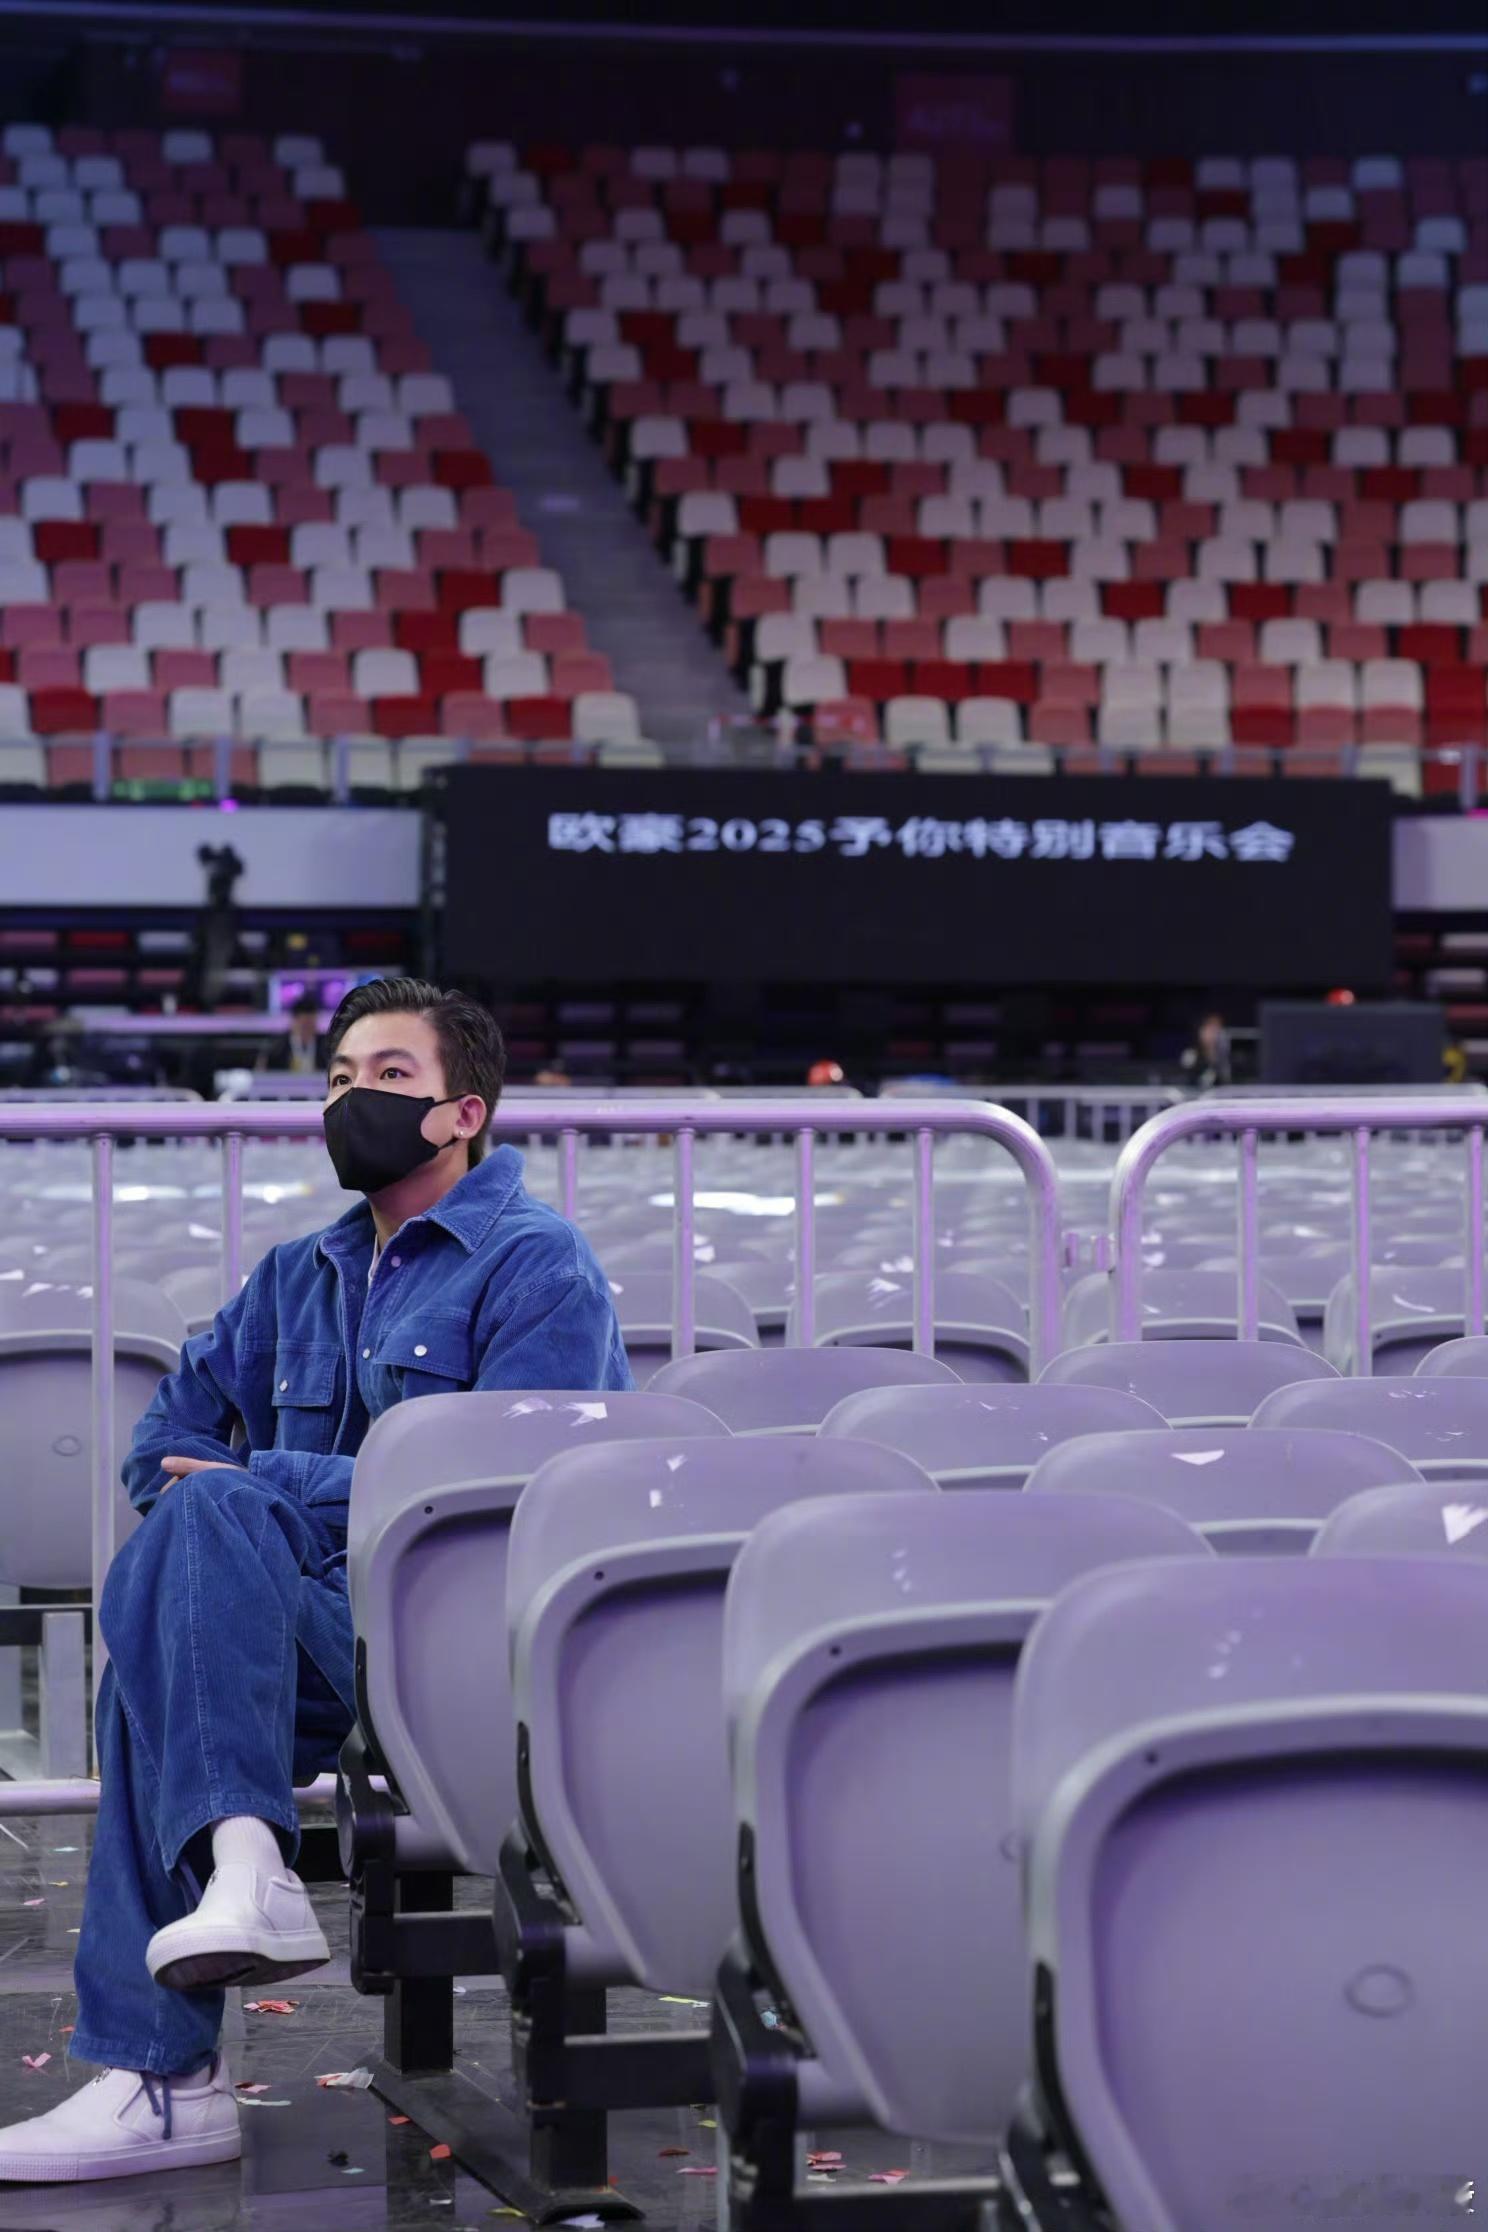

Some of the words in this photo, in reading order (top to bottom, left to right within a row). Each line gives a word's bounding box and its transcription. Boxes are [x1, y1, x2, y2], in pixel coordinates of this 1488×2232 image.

[547, 812, 1293, 862] 欧豪2025予你特别音乐会
